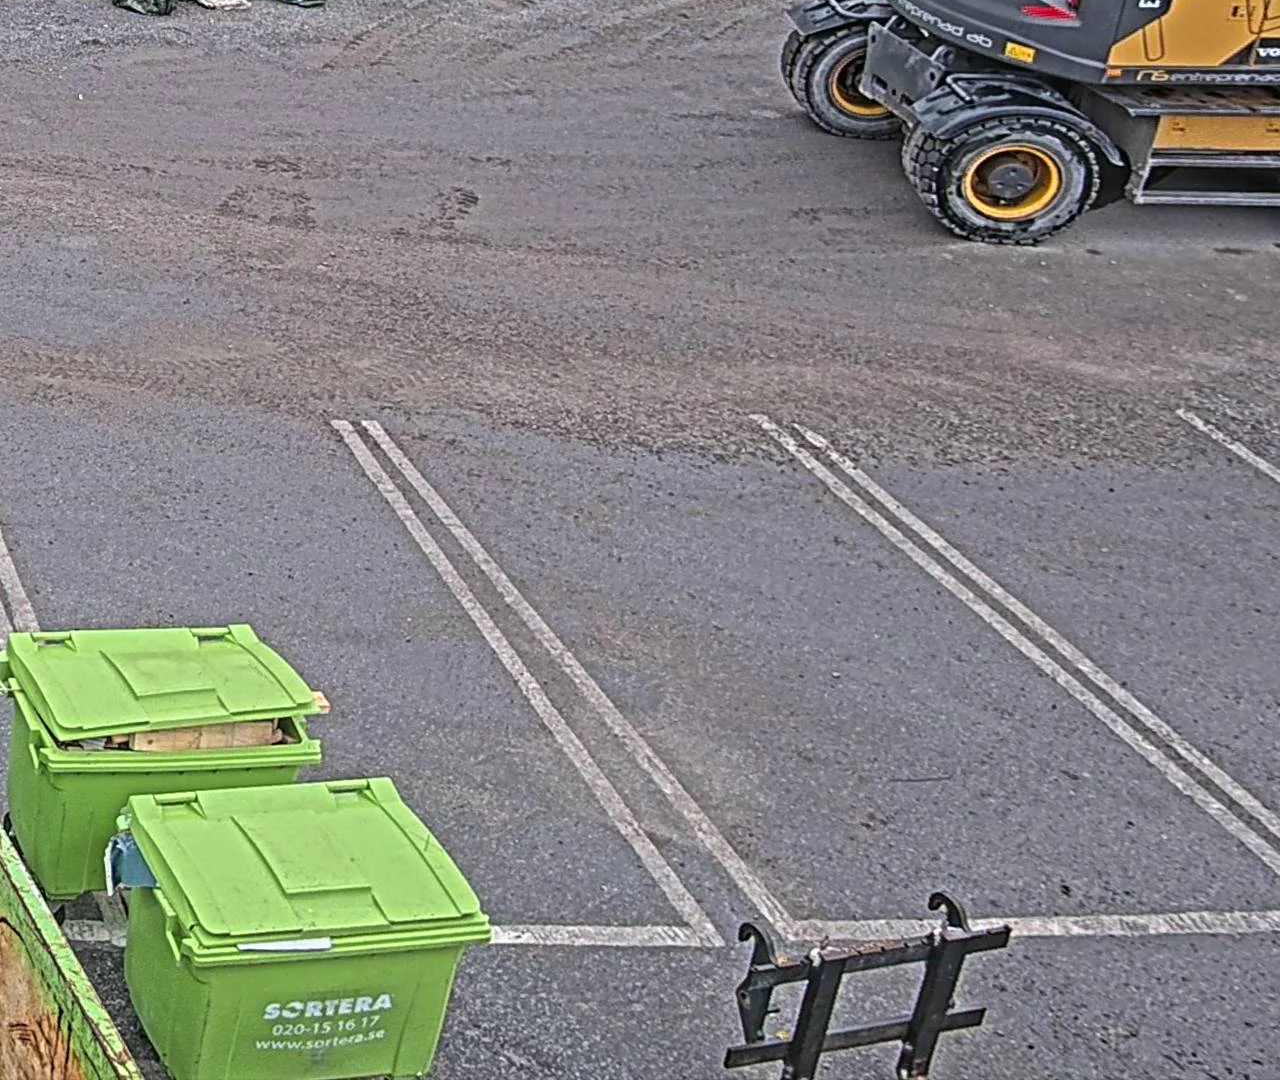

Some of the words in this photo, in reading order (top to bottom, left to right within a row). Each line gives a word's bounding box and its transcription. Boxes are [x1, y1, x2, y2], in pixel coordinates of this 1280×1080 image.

[263, 993, 393, 1020] SORTERA
[272, 1021, 331, 1036] 020-15
[338, 1020, 356, 1031] 16
[361, 1015, 381, 1028] 17
[255, 1028, 386, 1050] www.sortera.se
